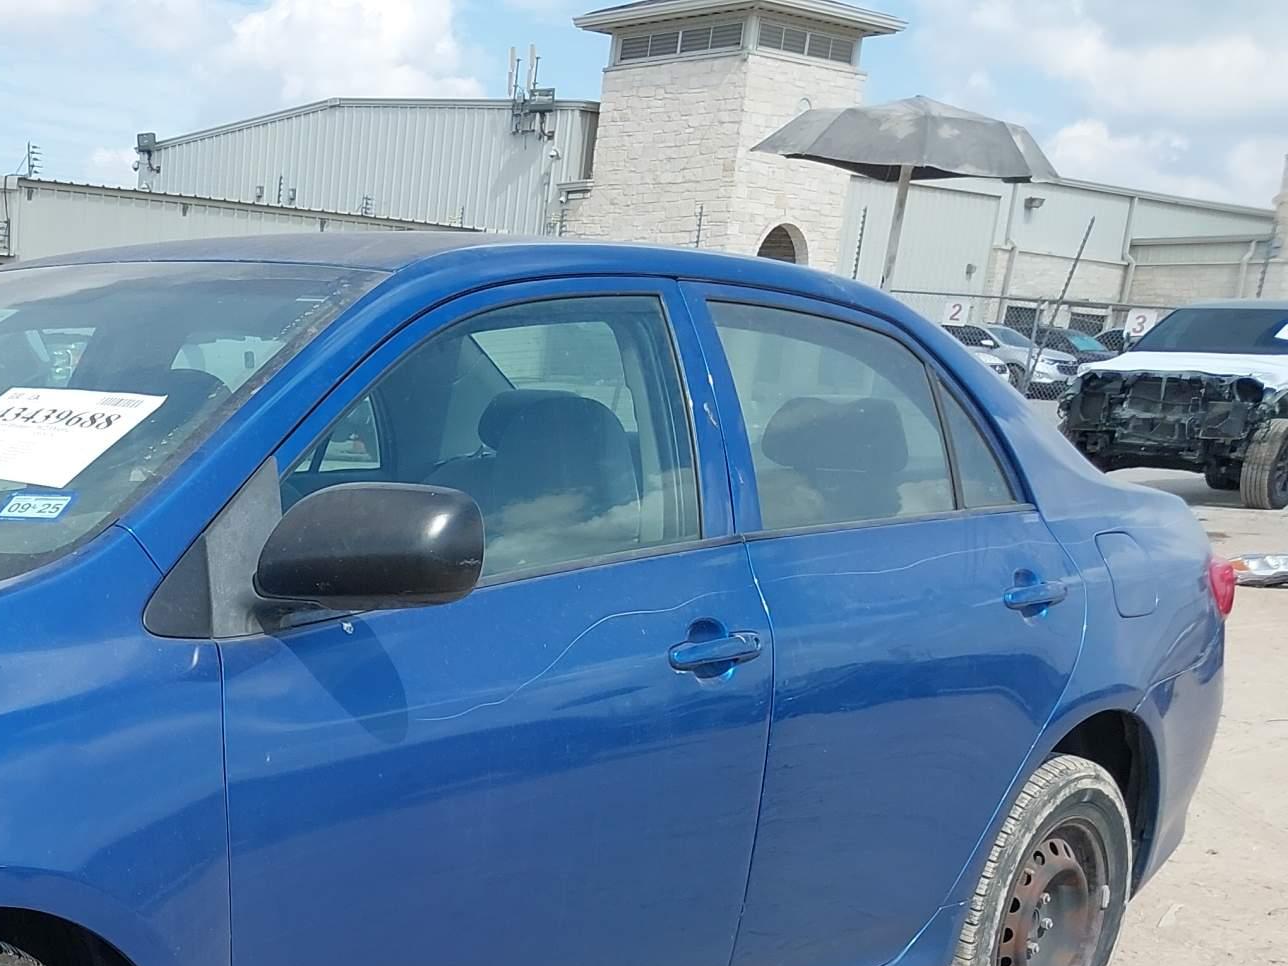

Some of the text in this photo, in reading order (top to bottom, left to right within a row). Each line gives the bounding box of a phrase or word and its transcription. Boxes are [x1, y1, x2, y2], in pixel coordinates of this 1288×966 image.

[949, 303, 962, 321] 2
[1132, 315, 1147, 334] 3
[7, 502, 63, 514] 09 25
